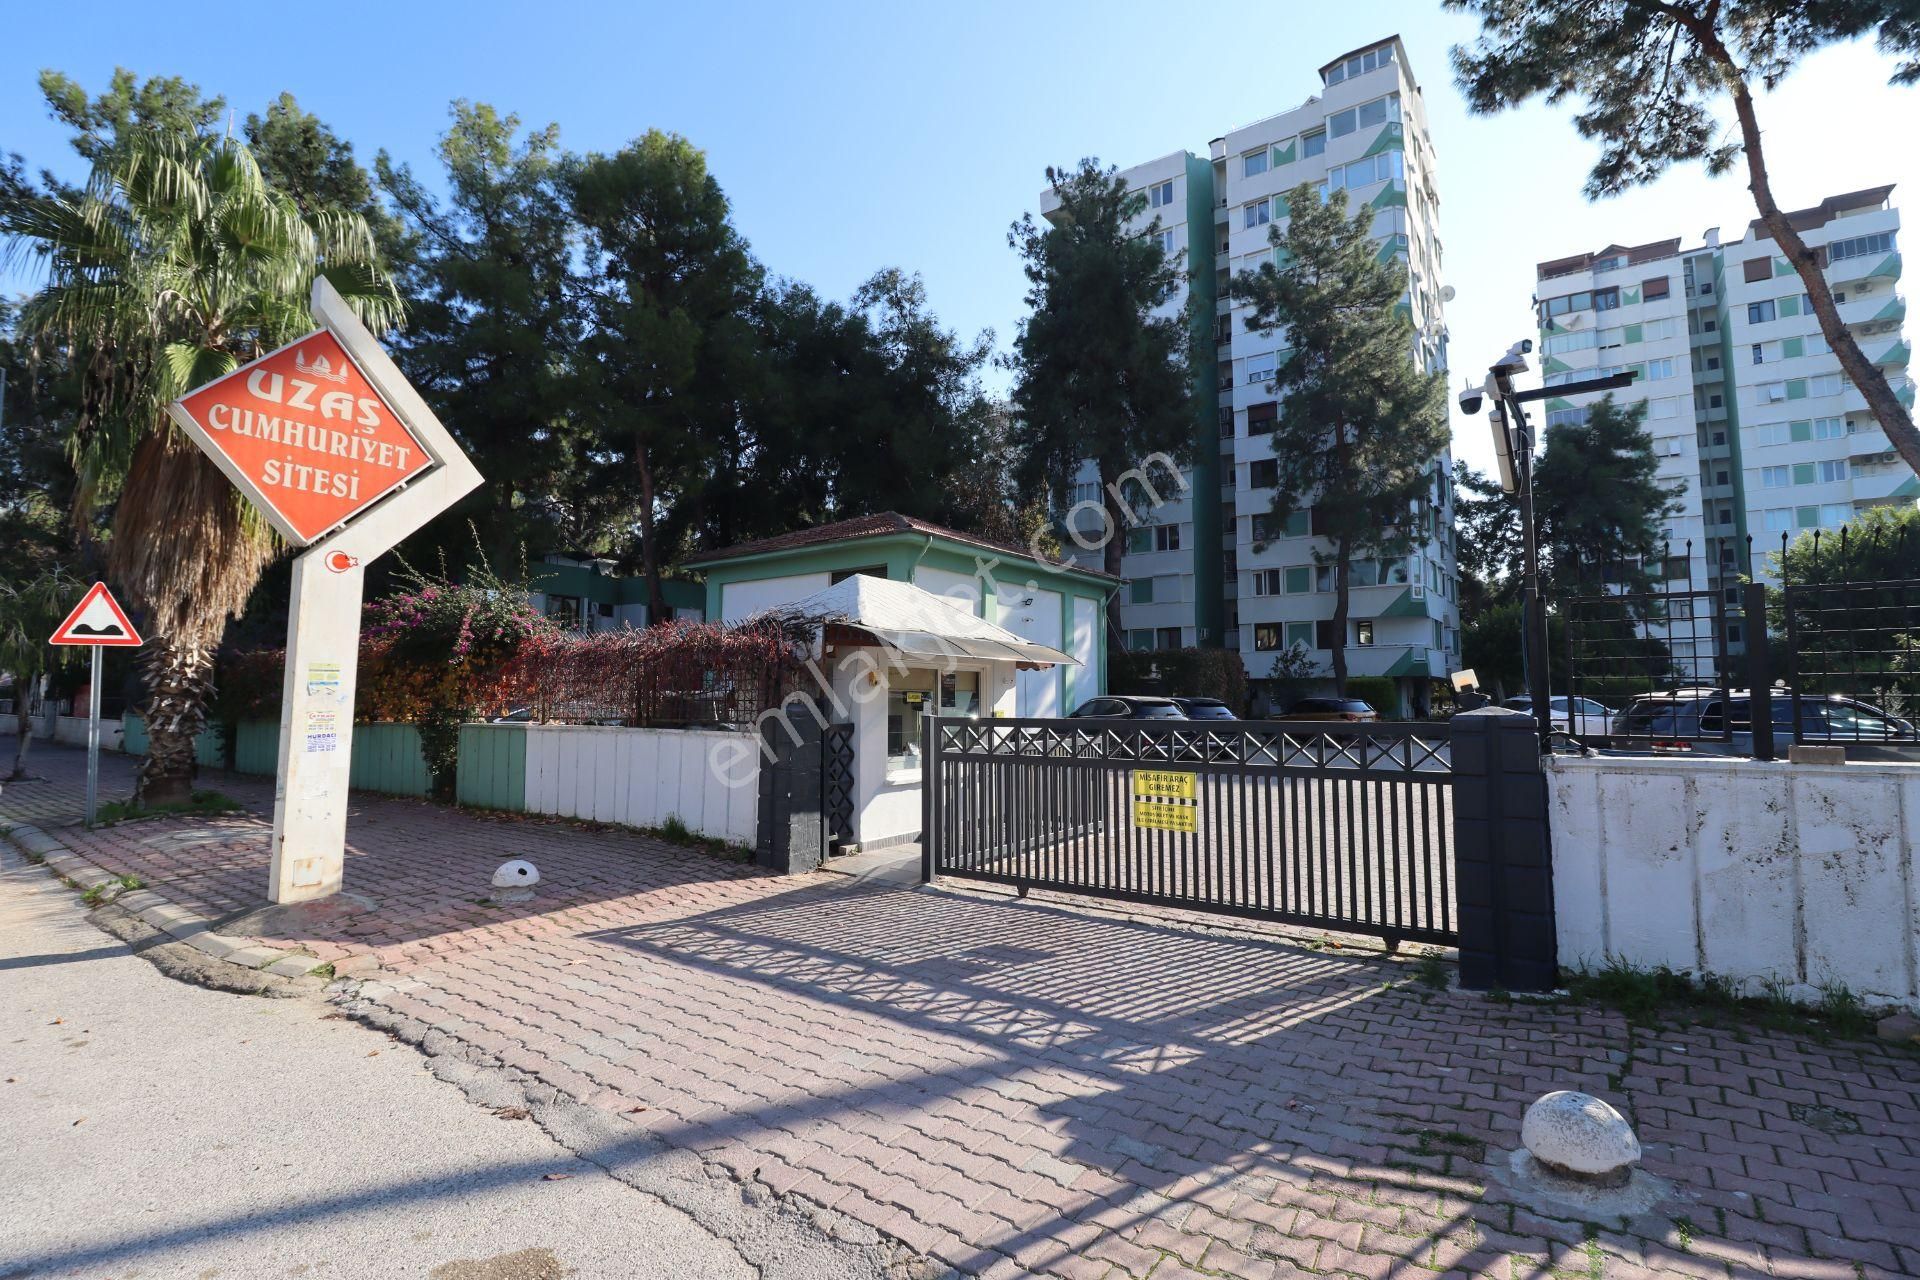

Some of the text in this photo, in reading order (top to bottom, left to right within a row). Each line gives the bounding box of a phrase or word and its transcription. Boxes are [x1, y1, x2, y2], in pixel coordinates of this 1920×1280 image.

[246, 368, 382, 434] UZAŞ
[208, 403, 410, 470] CUMHURİYET
[261, 455, 361, 501] SİTESİ
[1169, 775, 1188, 784] ARAÇ
